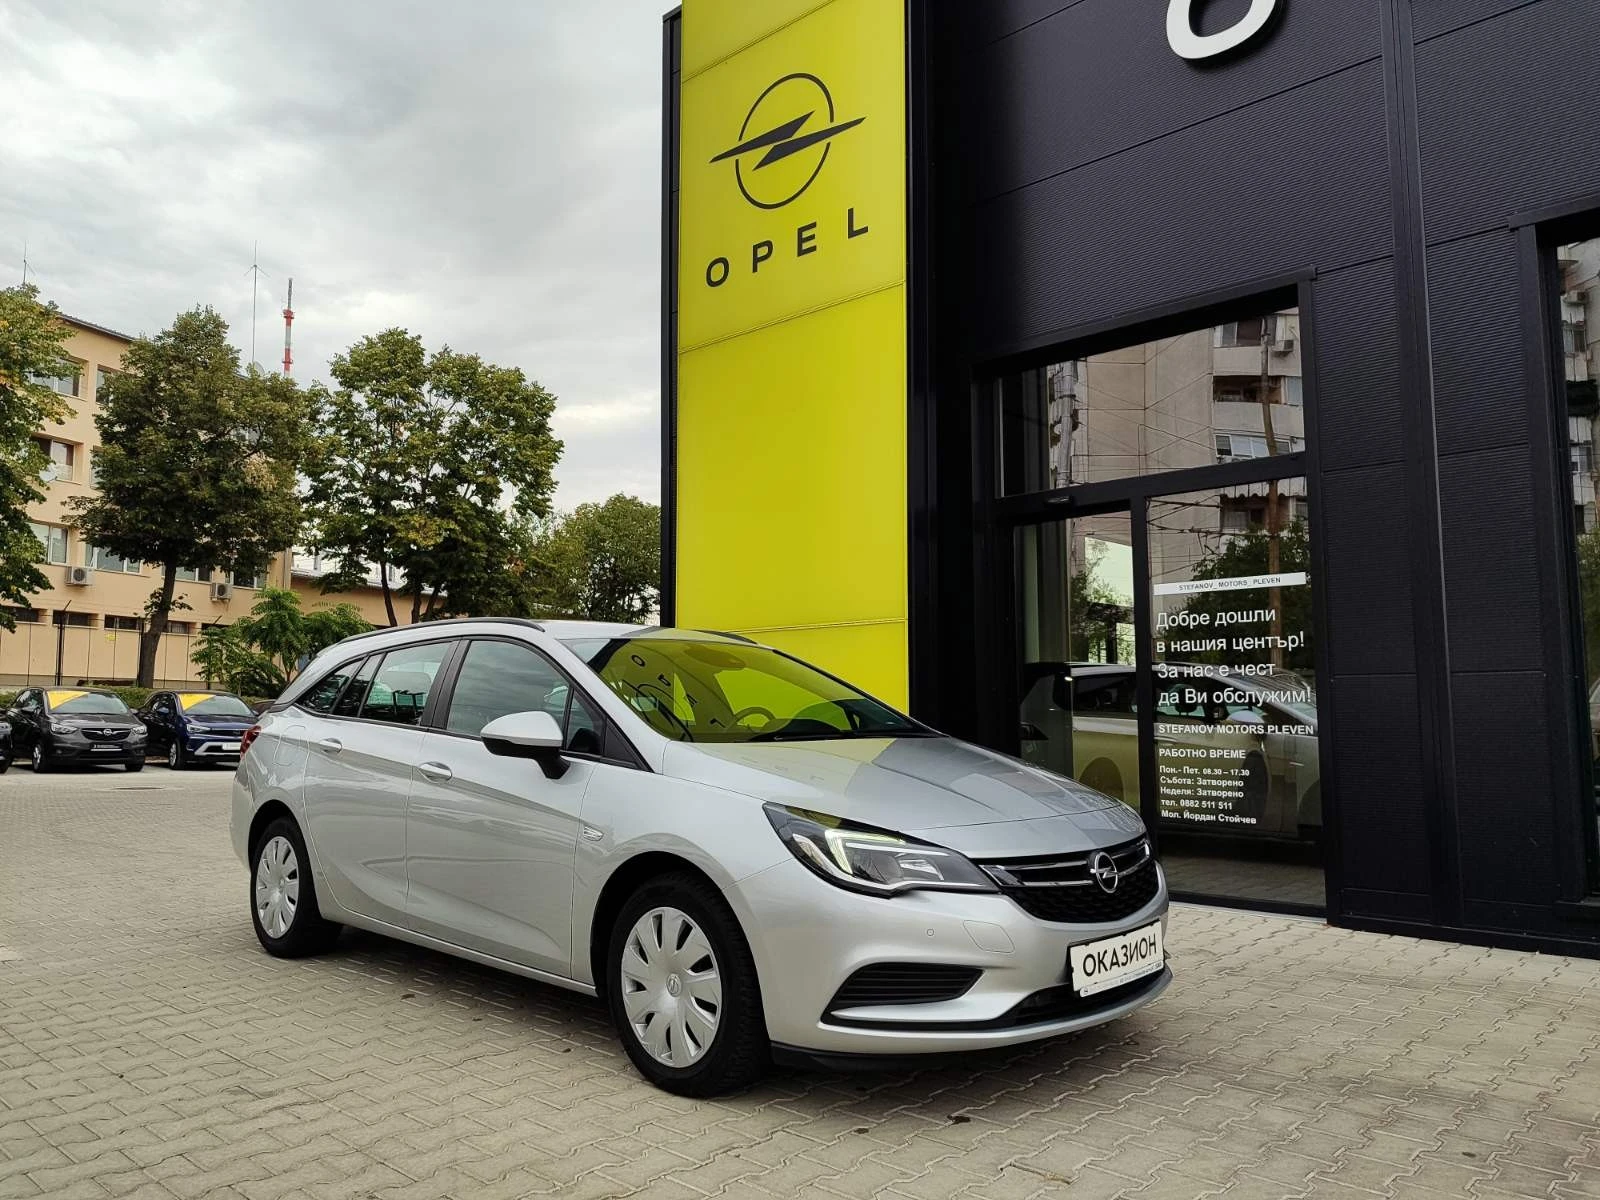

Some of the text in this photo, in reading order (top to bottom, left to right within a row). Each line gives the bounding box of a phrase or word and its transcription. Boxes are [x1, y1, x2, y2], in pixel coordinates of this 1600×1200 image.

[706, 207, 869, 287] OPEL
[1253, 576, 1281, 585] PLEVEN
[1156, 608, 1276, 631] Добре дошли
[1156, 630, 1305, 653] в нашия център!
[1157, 663, 1276, 679] За нас е чест
[1158, 686, 1311, 707] да Ви обслужим!
[1158, 724, 1314, 735] STEFANOV MOTORS PLEVEN
[1159, 748, 1246, 759] РАБОТНО ВРЕМЕ
[1183, 765, 1201, 775] Пет.
[1202, 767, 1222, 775] 08.30
[1230, 768, 1250, 776] 17.30
[1159, 776, 1244, 788] Събота: Затворено
[1160, 786, 1244, 799] Неделя: Затворено
[1161, 799, 1233, 810] тел. 0882 511 511
[1161, 809, 1257, 825] Мол. Йордан Стойчев
[1082, 932, 1157, 977] ОКАЗИОН
